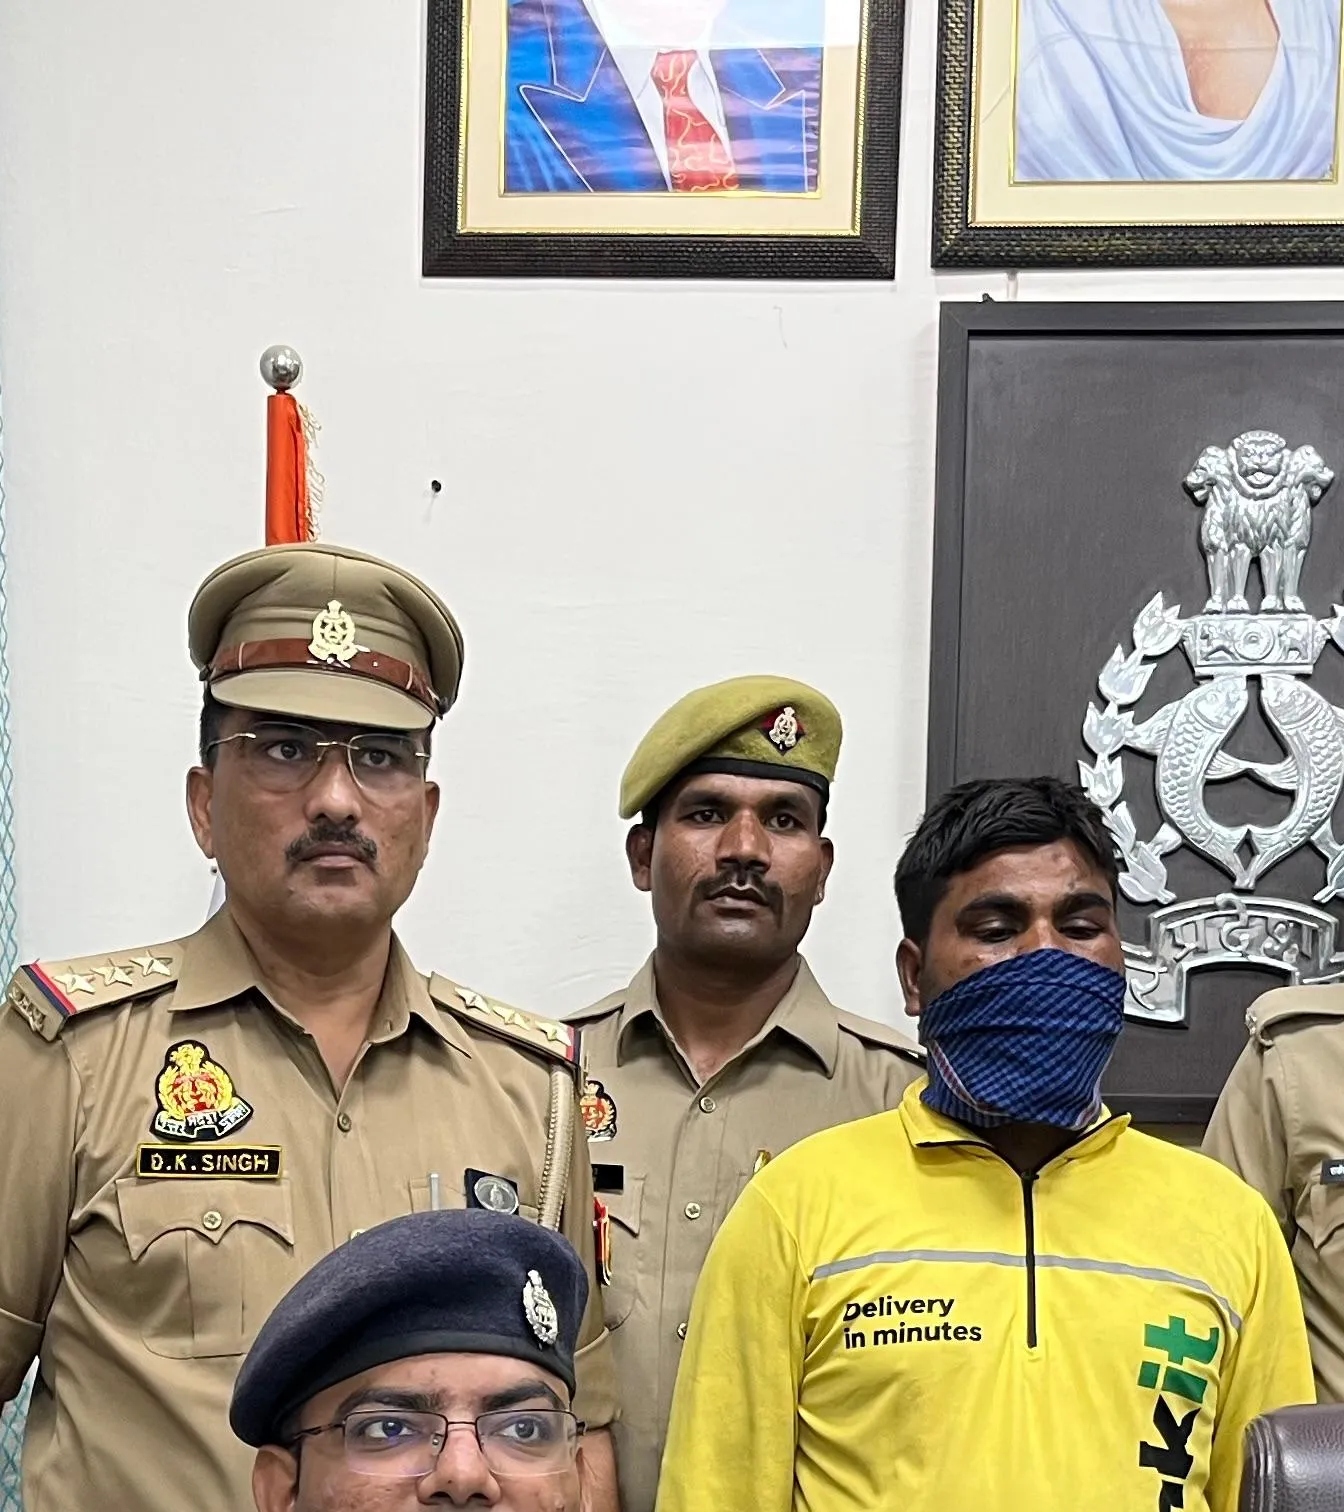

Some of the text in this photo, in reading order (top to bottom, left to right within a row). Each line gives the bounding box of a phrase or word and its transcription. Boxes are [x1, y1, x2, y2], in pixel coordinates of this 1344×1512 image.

[843, 1295, 955, 1323] Delivery
[843, 1321, 982, 1350] in minutes
